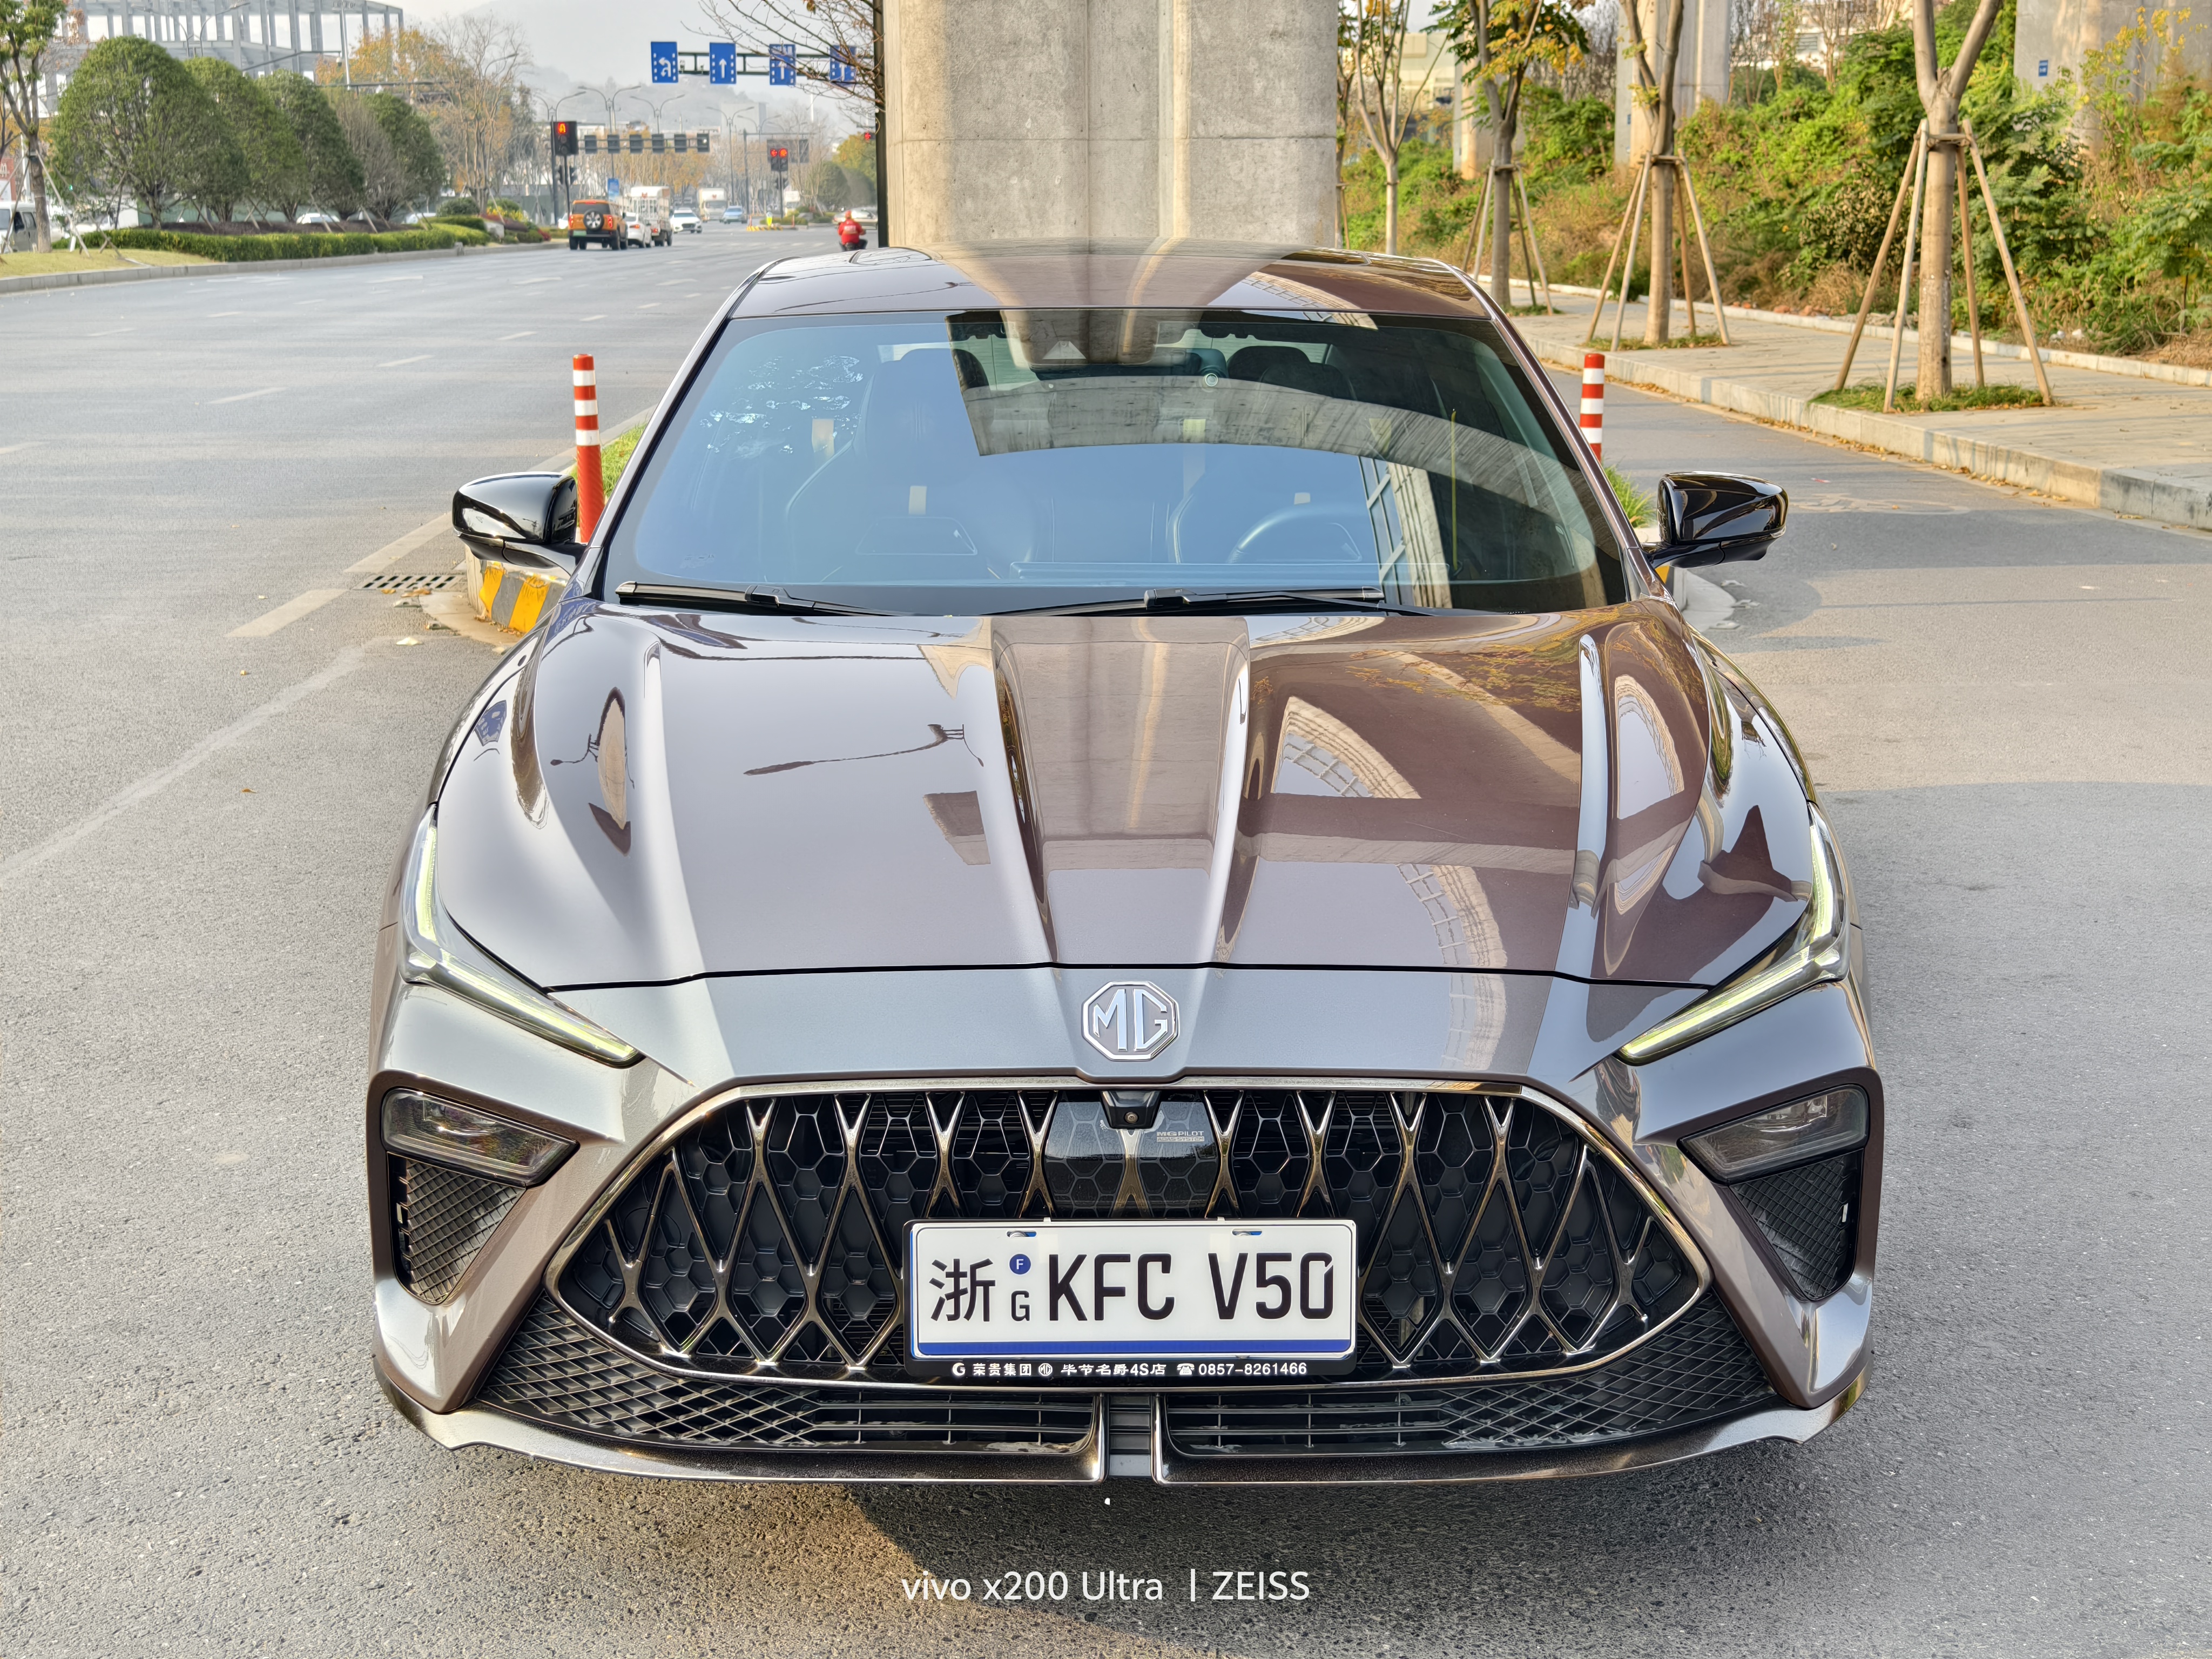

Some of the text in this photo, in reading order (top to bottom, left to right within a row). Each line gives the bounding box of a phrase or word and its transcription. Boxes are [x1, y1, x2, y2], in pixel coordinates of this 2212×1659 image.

[1091, 988, 1169, 1053] MG
[1016, 1258, 1024, 1270] F
[929, 1252, 1333, 1322] 浙 G KFC V50
[973, 1363, 1031, 1377] 荣贵集团
[1198, 1362, 1307, 1375] 0857-8261466
